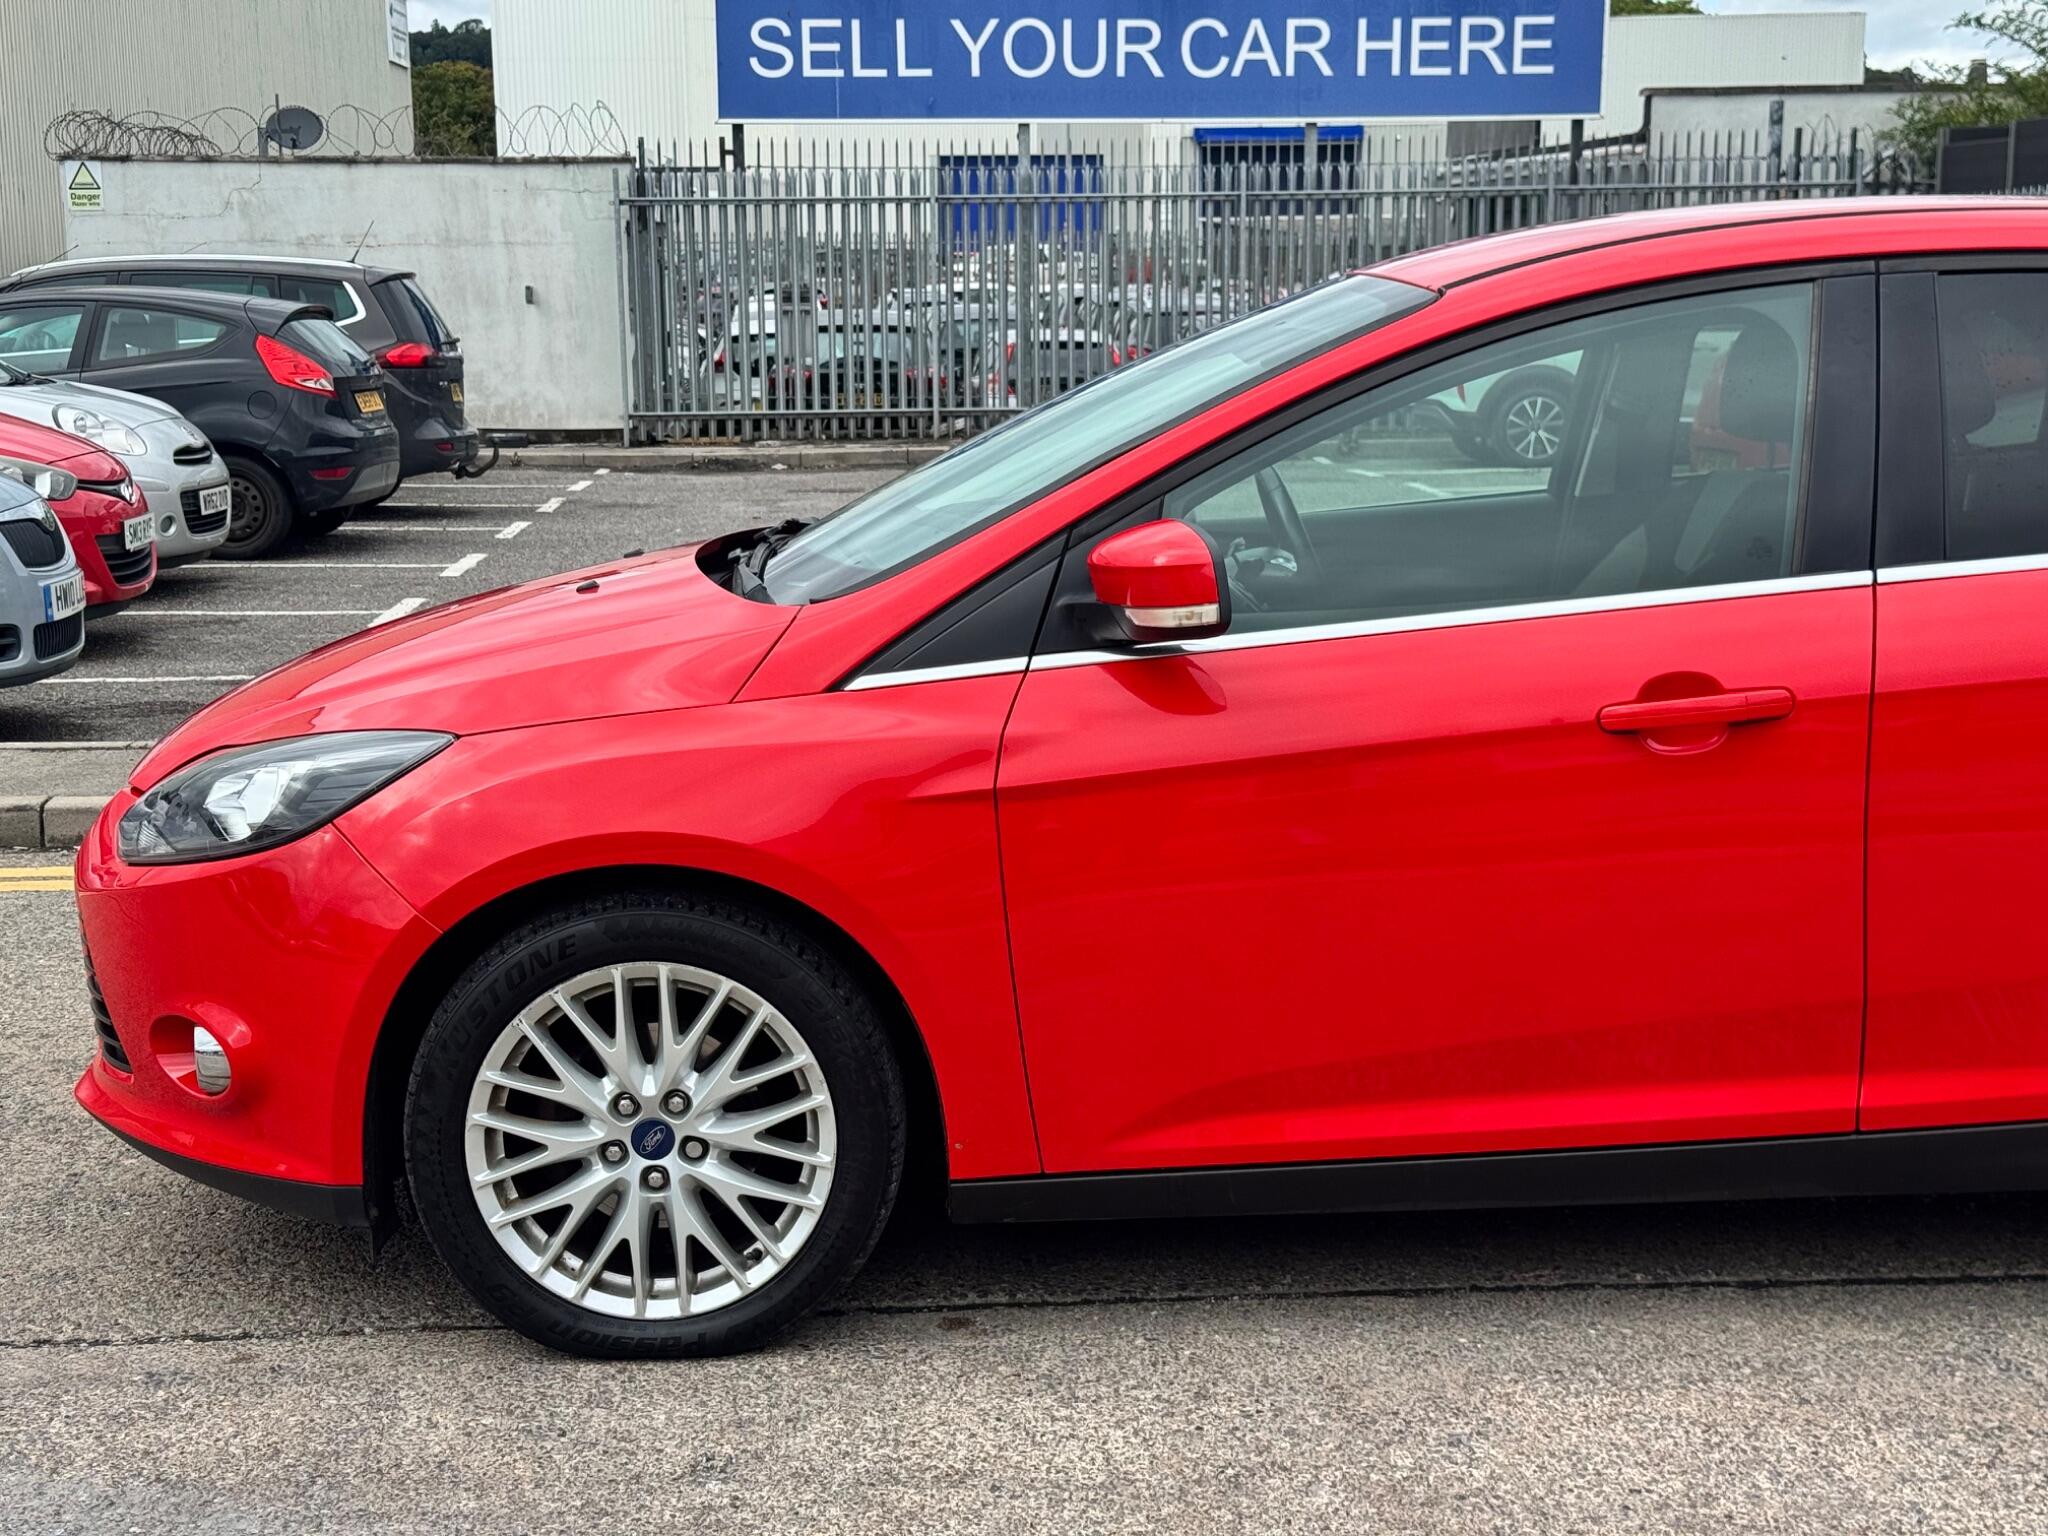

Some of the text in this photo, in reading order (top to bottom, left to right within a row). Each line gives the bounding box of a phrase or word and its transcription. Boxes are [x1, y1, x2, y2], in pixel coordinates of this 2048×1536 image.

[749, 15, 1555, 79] SELL YOUR CAR HERE
[70, 192, 101, 201] Danger
[55, 581, 75, 612] HW10
[442, 934, 577, 1075] KUSTONE
[644, 1130, 663, 1150] Ford
[544, 1320, 709, 1354] Passion
